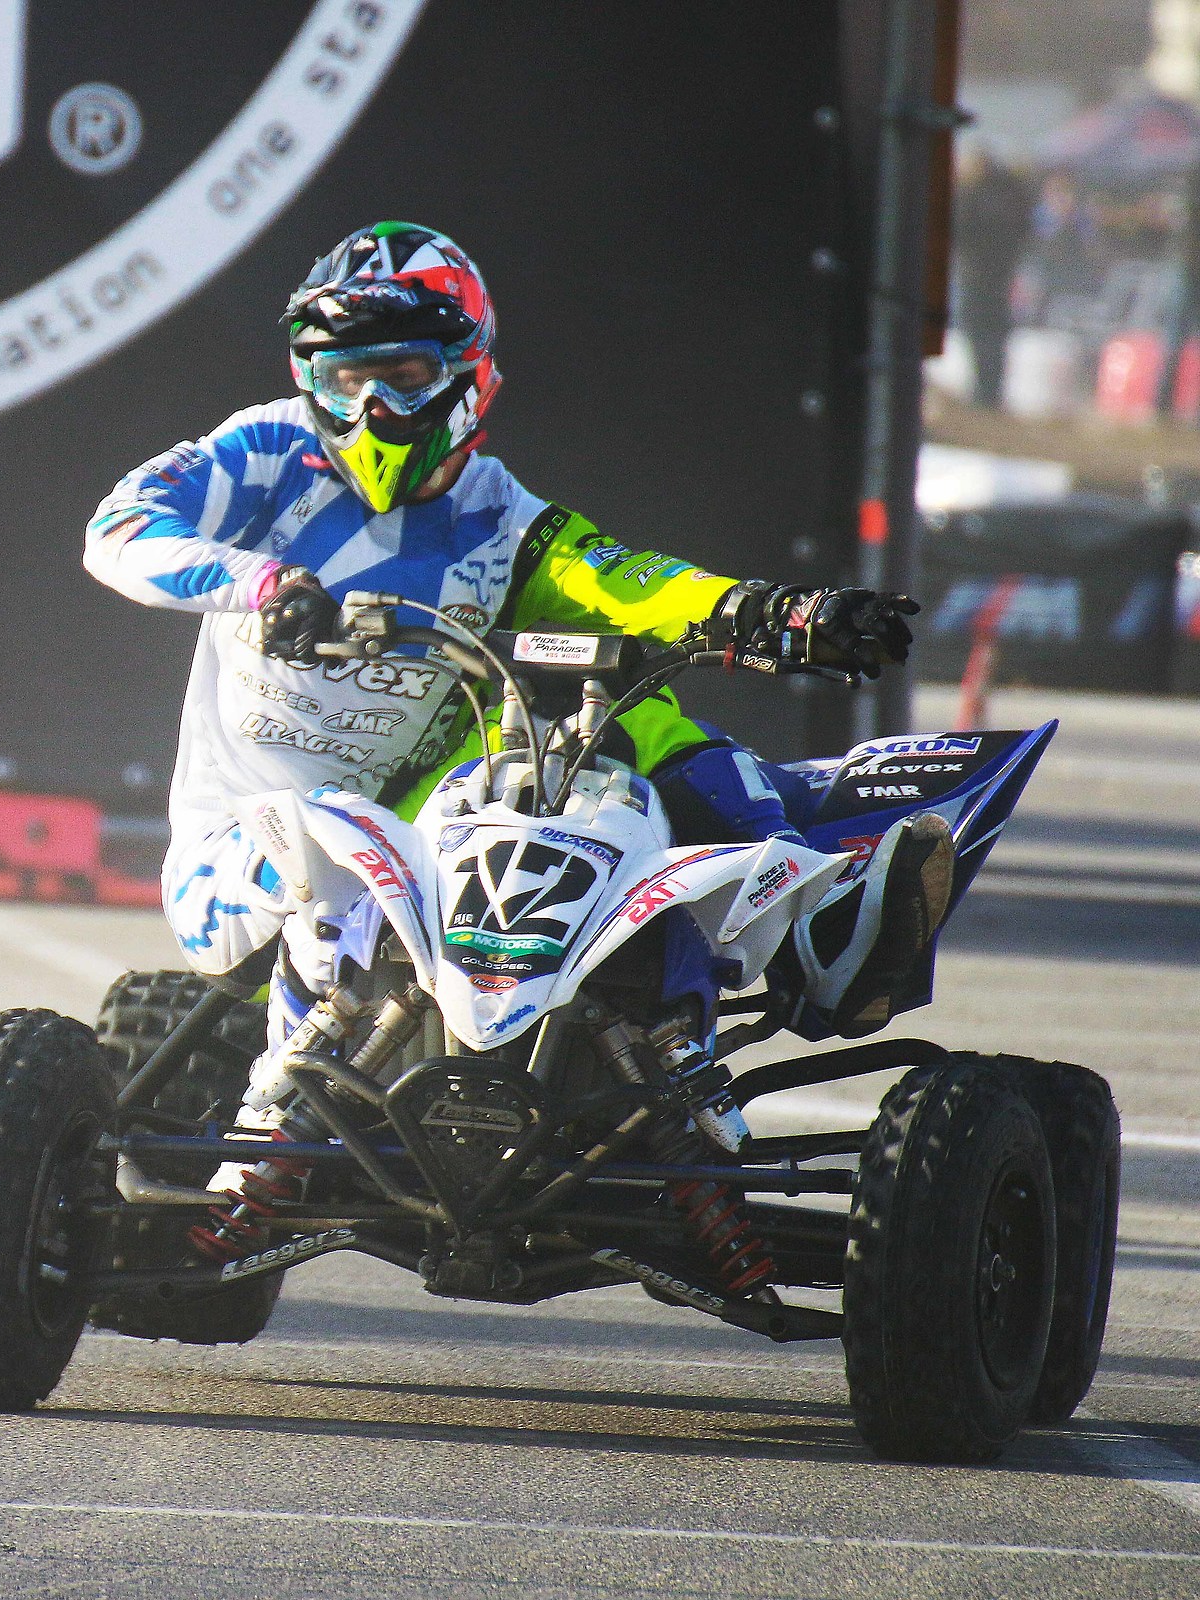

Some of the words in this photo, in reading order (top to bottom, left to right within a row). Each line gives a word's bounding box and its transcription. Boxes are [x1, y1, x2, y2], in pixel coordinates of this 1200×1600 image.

[206, 118, 300, 217] one
[340, 709, 394, 737] FMR
[240, 712, 373, 764] DRAGON
[843, 763, 963, 780] Movex
[857, 785, 922, 798] FMR
[539, 827, 618, 866] DRAGON
[473, 934, 547, 951] MOTOREX
